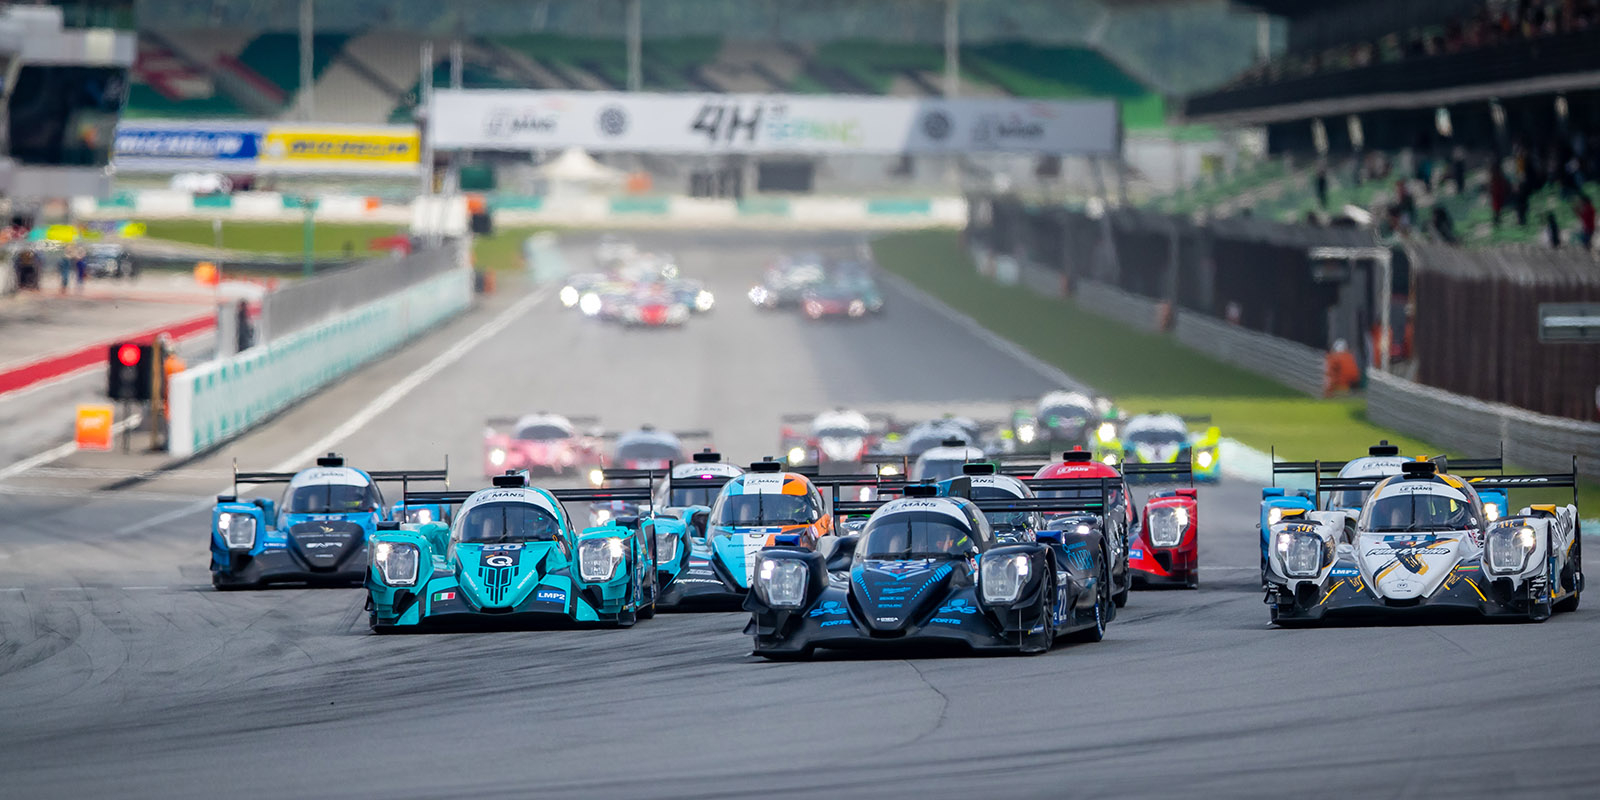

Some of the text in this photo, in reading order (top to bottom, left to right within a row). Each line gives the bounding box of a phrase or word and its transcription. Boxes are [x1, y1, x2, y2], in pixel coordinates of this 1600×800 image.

[691, 103, 764, 142] 4H
[481, 543, 523, 551] 50
[538, 591, 566, 600] LMP2
